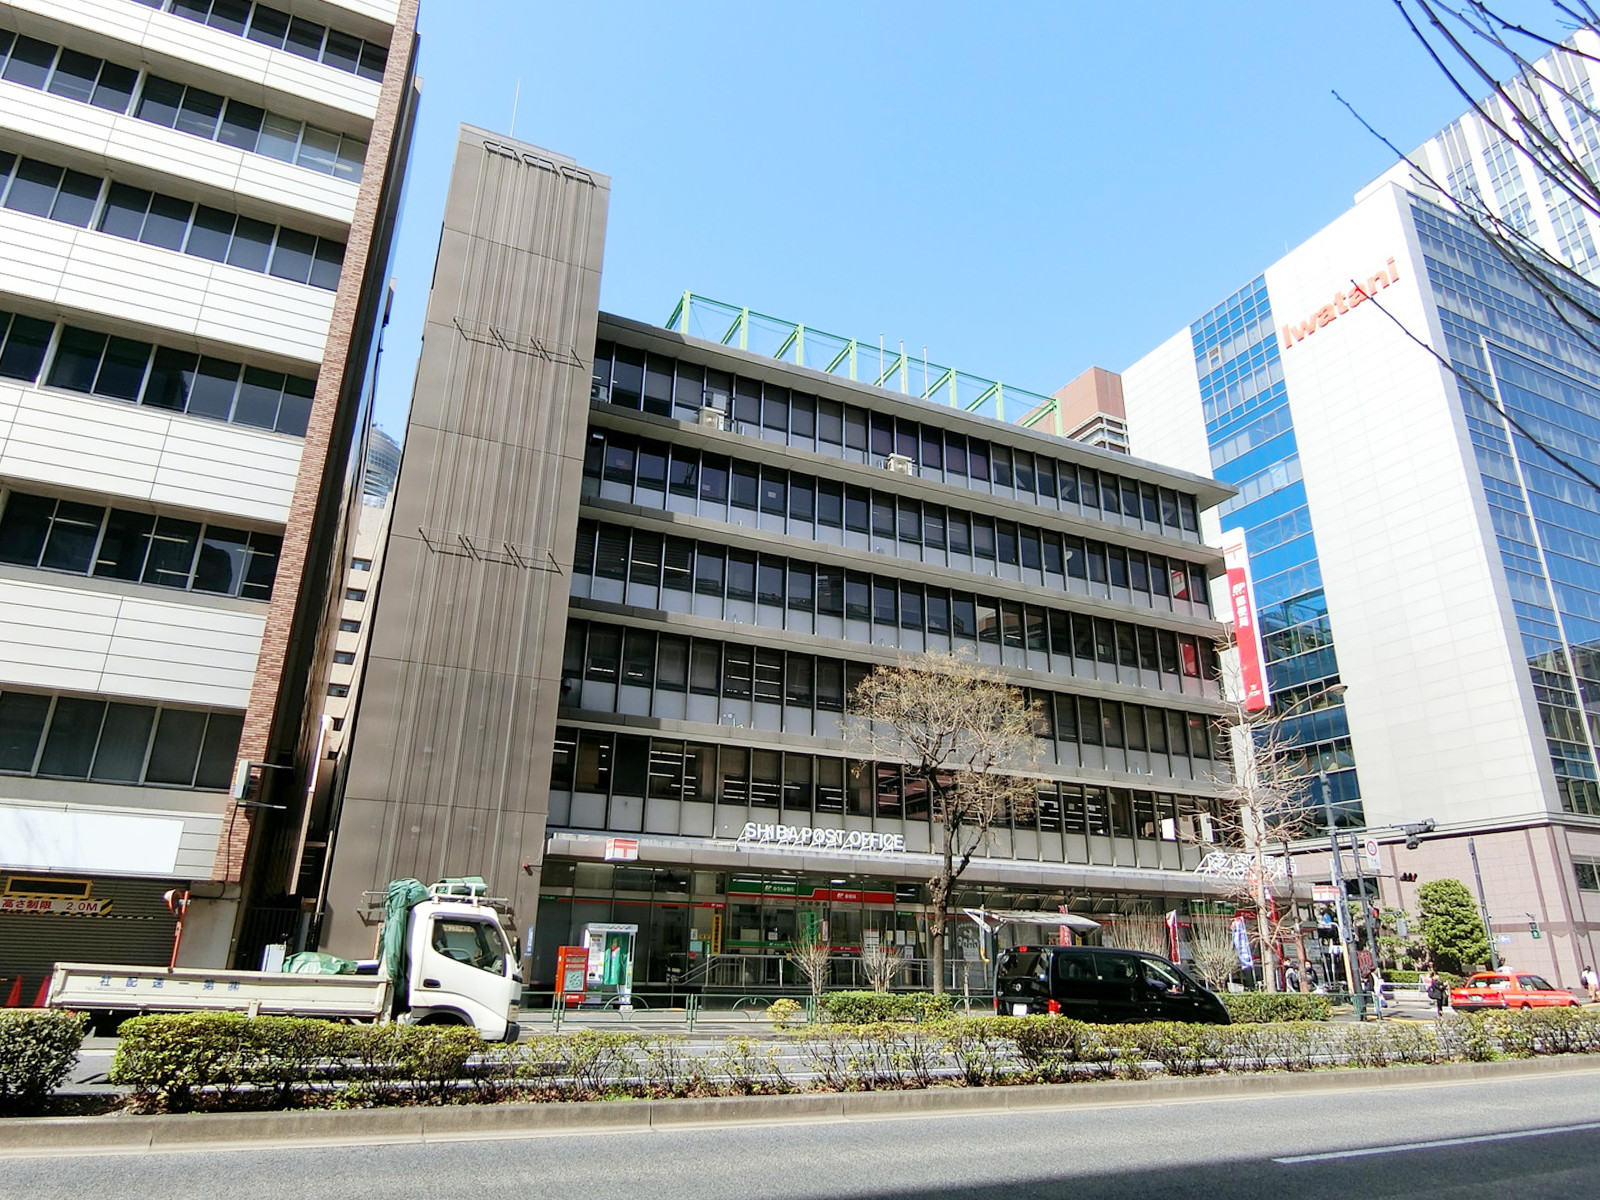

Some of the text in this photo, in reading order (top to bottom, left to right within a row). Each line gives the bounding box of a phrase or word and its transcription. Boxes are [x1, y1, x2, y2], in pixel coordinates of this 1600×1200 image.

[1281, 255, 1400, 349] Iwatani
[743, 822, 906, 851] SHIBA POST OFFICE
[1, 898, 99, 912] 高さ制限 2.0M
